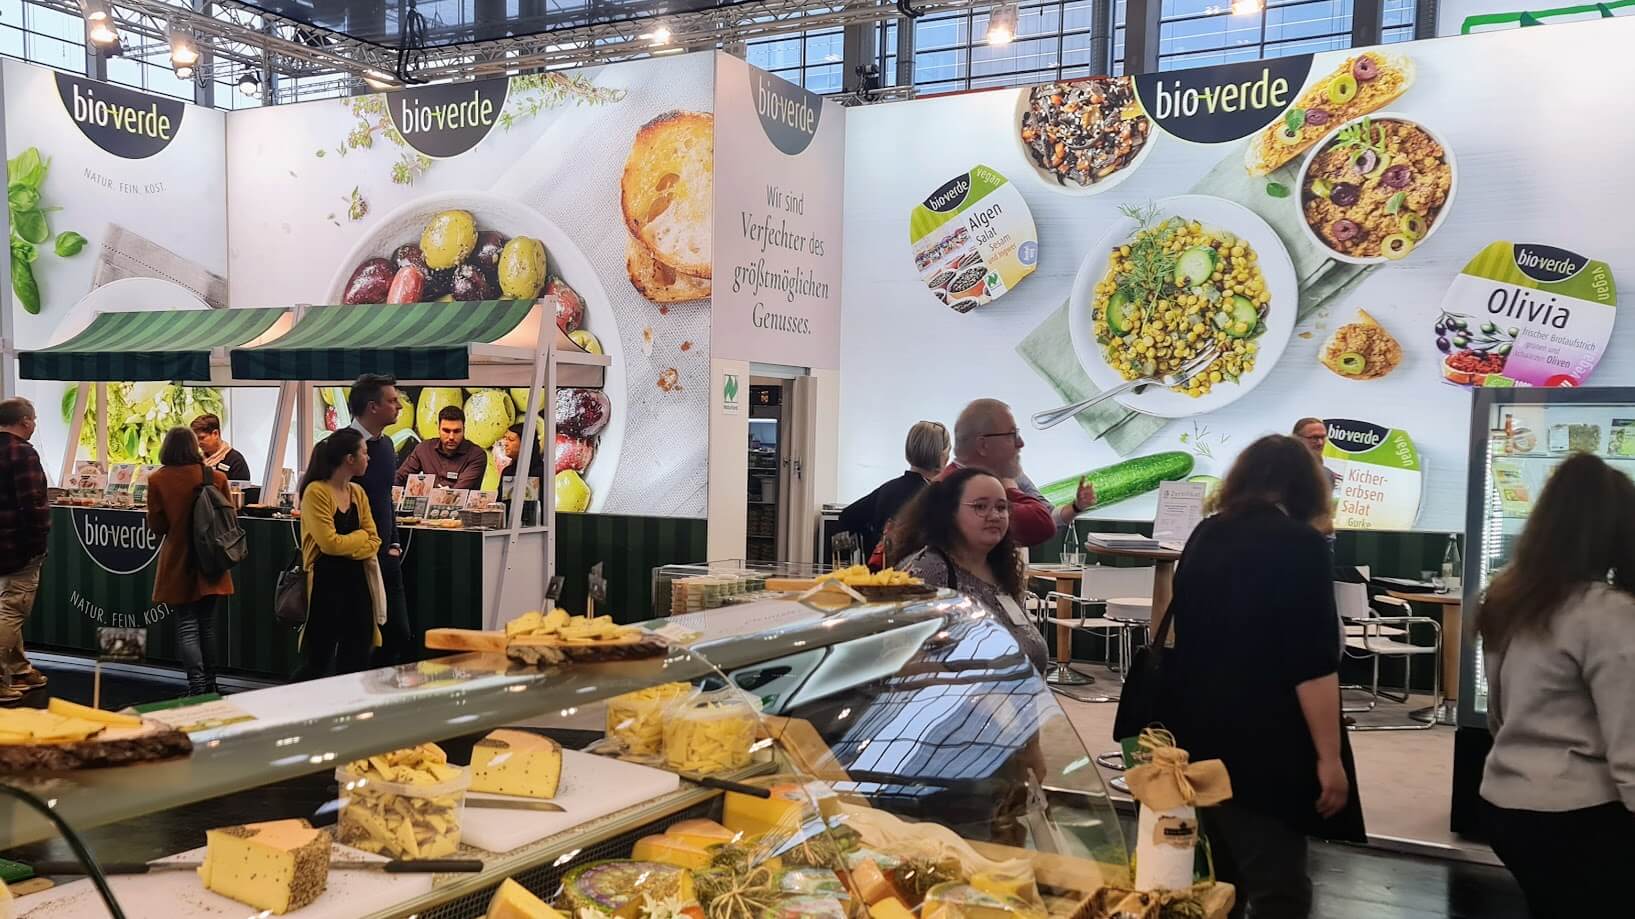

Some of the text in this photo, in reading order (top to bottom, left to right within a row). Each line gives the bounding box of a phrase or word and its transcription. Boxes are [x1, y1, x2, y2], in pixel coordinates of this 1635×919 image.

[975, 167, 1001, 187] vegan
[766, 183, 804, 216] Wir sind
[968, 203, 1002, 232] Algen
[741, 210, 825, 257] Verfechter des
[975, 226, 998, 246] Salat
[732, 257, 830, 303] größtmöglichen
[1591, 266, 1611, 301] vegan
[751, 302, 813, 335] Genusses.
[1487, 287, 1571, 330] Olivia
[1551, 334, 1596, 351] Brotaufstrich
[1545, 355, 1572, 369] Oliven
[1394, 435, 1414, 467] vegan
[1348, 468, 1388, 487] Kicher-
[1342, 500, 1370, 516] Salat
[1345, 485, 1384, 503] erbsen
[70, 590, 174, 628] NATUR. FEIN. KOST.
